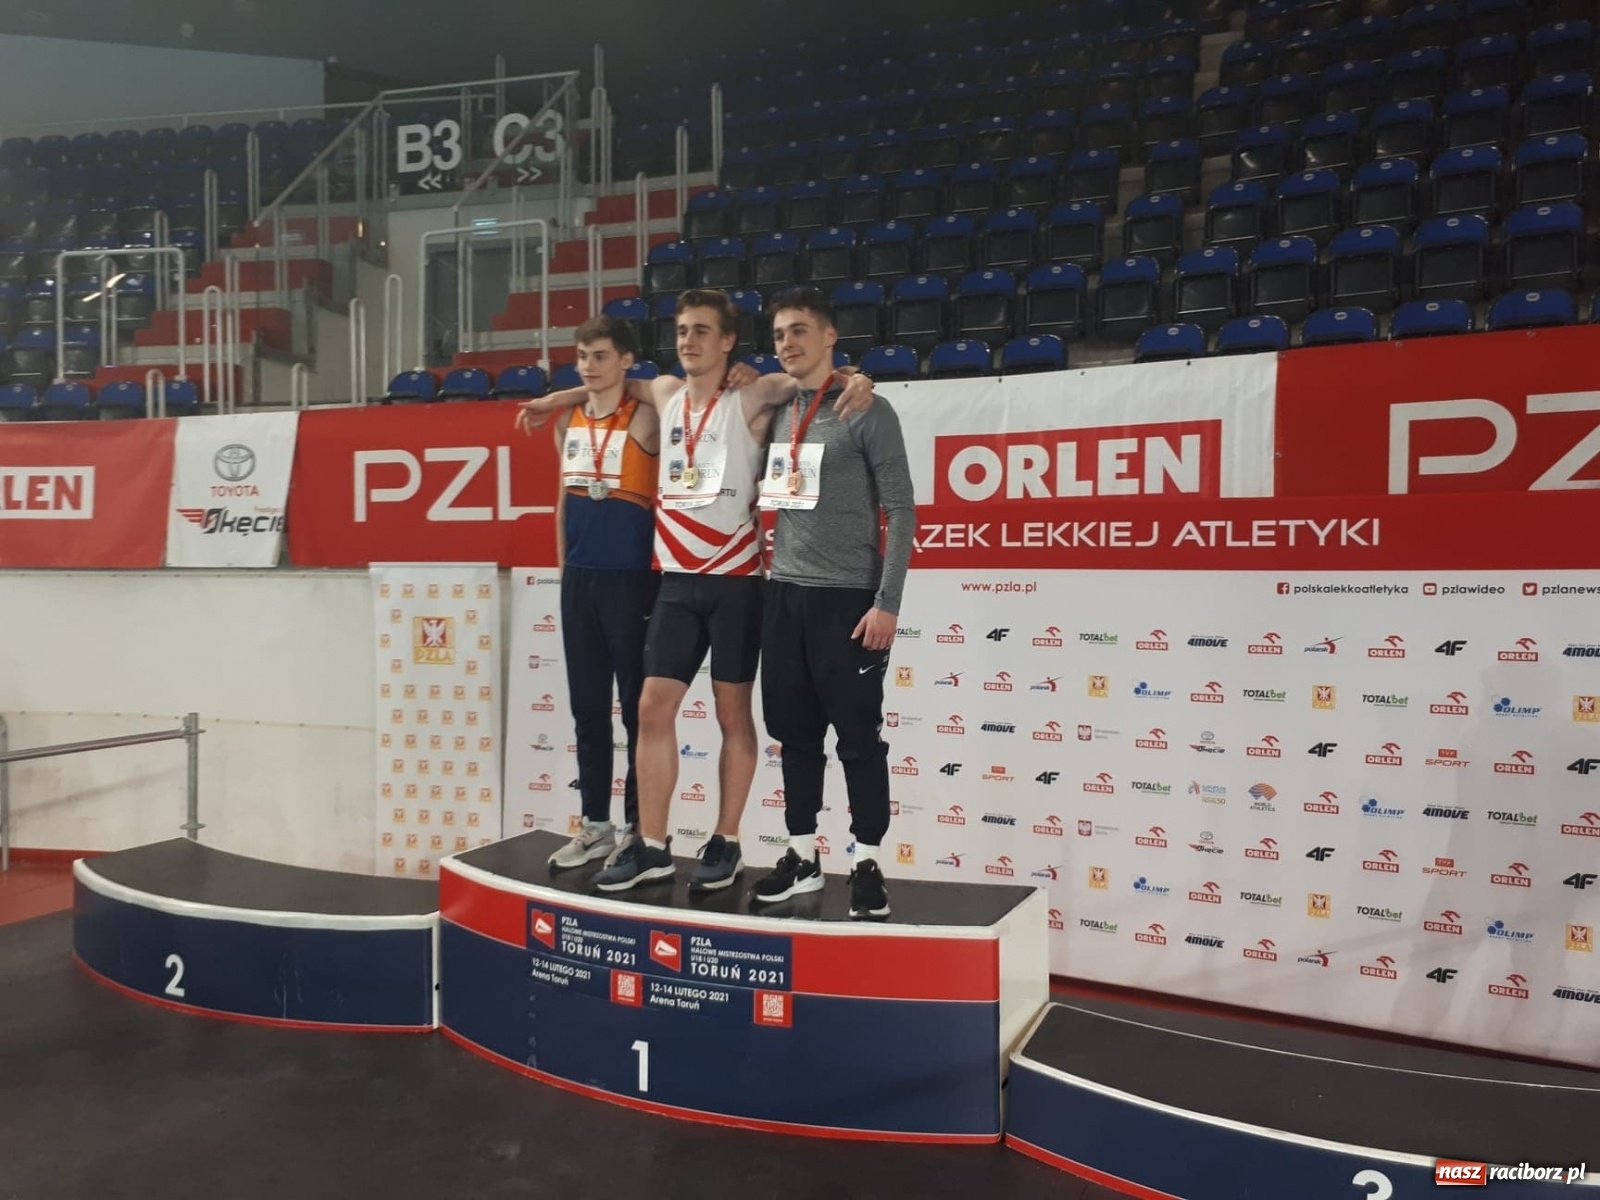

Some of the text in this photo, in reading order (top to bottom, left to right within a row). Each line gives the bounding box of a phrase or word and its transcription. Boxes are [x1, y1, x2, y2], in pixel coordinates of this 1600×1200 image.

[493, 109, 564, 165] C3
[397, 119, 462, 173] B3
[947, 434, 1201, 501] ORLEN
[354, 445, 555, 522] PZL
[0, 475, 83, 510] LEN
[210, 485, 260, 497] TOYOTA
[1001, 521, 1159, 548] LEKKIEJ
[1172, 518, 1380, 547] ATLETYKI
[961, 581, 1037, 594] www.pzla.pl
[1293, 583, 1409, 596] polskalekkoatletyka
[1441, 583, 1506, 596] pzlawideo
[986, 628, 1010, 641] 4F
[1249, 646, 1282, 654] ORLEN
[1369, 649, 1404, 657] ORLEN
[1434, 640, 1467, 656] 4F
[1499, 652, 1537, 660] ORLEN
[1192, 694, 1222, 702] ORLEN
[1243, 689, 1286, 699] TOTALbet
[1431, 705, 1467, 714] ORLEN
[1502, 706, 1541, 714] OLIMP
[1137, 740, 1166, 748] ORLEN
[1308, 742, 1338, 757] 4F
[1248, 748, 1280, 756] ORLEN
[1367, 756, 1401, 765] ORLEN
[1425, 759, 1470, 768] SPORT
[1566, 758, 1600, 774] 4F
[939, 763, 962, 776] 4F
[1495, 764, 1533, 774] ORLEN
[1036, 771, 1060, 784] 4F
[1084, 784, 1113, 793] ORLEN
[1305, 804, 1338, 813] ORLEN
[939, 816, 964, 824] ORLEN
[1487, 811, 1538, 824] TOTALbet
[1034, 826, 1062, 835] ORLEN
[1137, 838, 1166, 847] ORLEN
[1246, 850, 1278, 859] ORLEN
[1306, 846, 1335, 862] 4F
[1364, 862, 1398, 872] ORLEN
[1422, 867, 1467, 878] SPORT
[1492, 875, 1530, 886] ORLEN
[1563, 873, 1598, 889] 4F
[1190, 892, 1220, 903] ORLEN
[562, 916, 578, 927] PZLA
[1425, 922, 1461, 933] ORLEN
[1136, 934, 1165, 944] ORLEN
[1496, 930, 1534, 939] OLIMP
[690, 936, 712, 947] PZLA
[562, 940, 636, 966] TORUŃ 2021
[690, 948, 784, 962] HALOWE MISTRZOSTWA POLSKI
[1244, 949, 1276, 960] ORLEN
[164, 954, 185, 997] 2
[549, 960, 574, 976] LUTEGO
[575, 968, 591, 980] 2021
[690, 962, 784, 984] TORUŃ 2021
[1361, 967, 1396, 978] ORLEN
[1426, 967, 1458, 983] 4F
[532, 969, 568, 986] Arena Toruń
[650, 982, 729, 1002] 12-14 LUTEGO 2021
[1490, 985, 1528, 998] ORLEN
[650, 995, 675, 1007] Arena
[676, 996, 700, 1010] Toruń
[630, 1040, 648, 1092] 1
